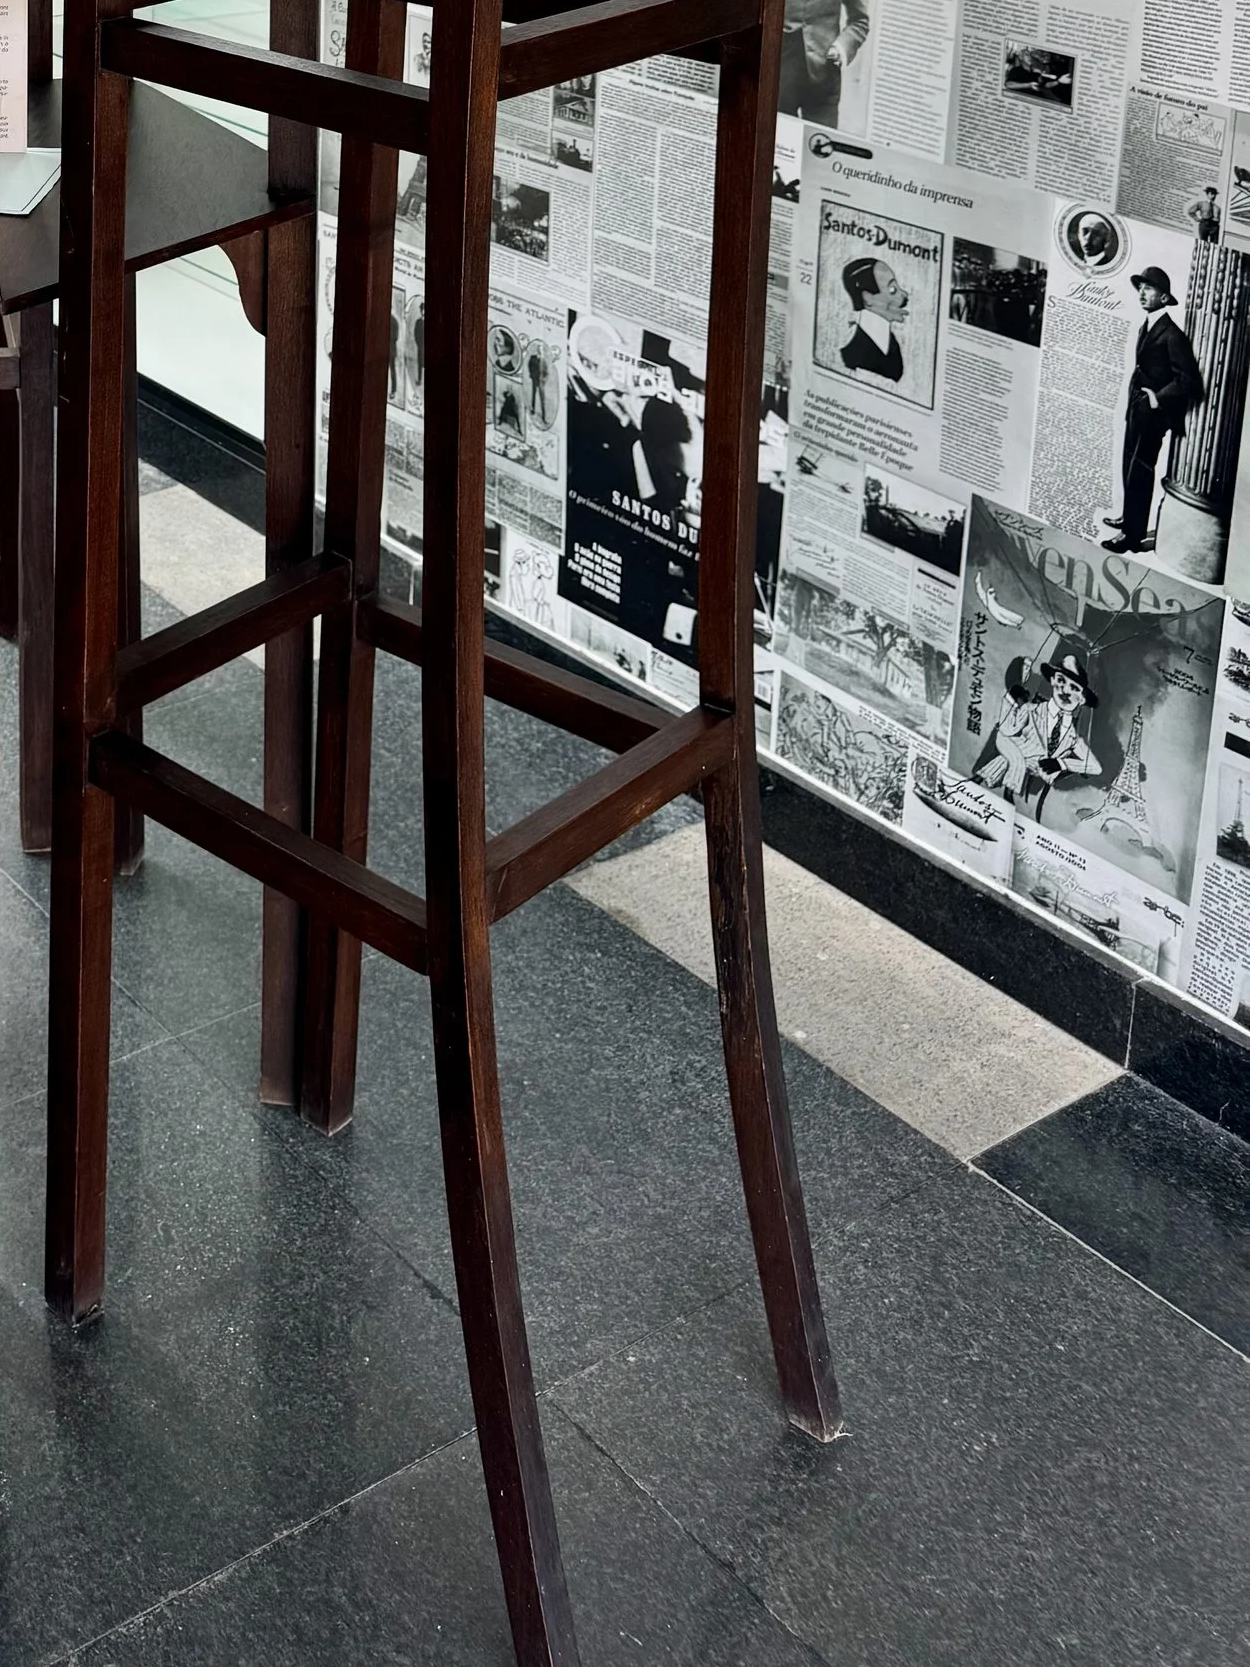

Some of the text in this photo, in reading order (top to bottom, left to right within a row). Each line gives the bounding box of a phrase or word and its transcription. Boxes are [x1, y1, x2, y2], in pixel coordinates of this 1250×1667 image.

[1137, 89, 1153, 97] visão
[1164, 94, 1185, 105] futuro
[832, 161, 973, 209] O queridinho da imprensa
[800, 272, 812, 285] 22
[612, 490, 670, 530] SANTOS
